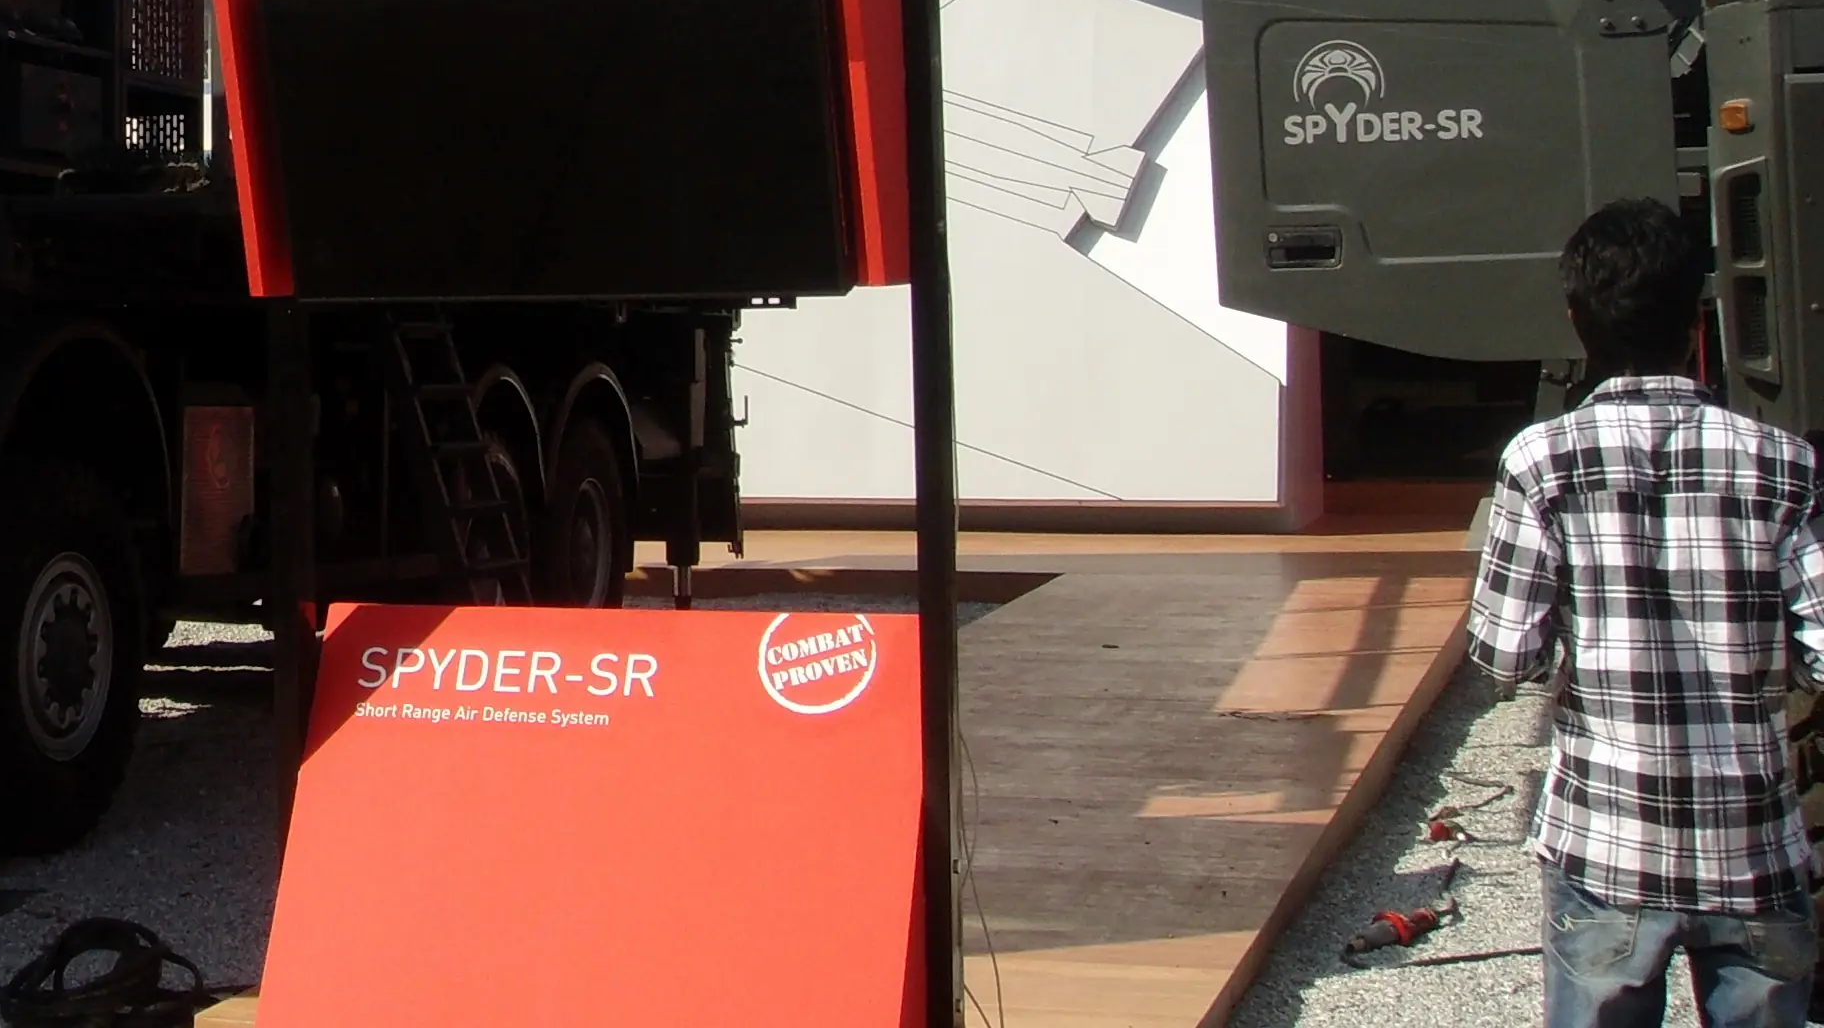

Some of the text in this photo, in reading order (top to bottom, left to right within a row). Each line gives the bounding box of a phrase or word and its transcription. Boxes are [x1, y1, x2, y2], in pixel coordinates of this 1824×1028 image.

[1283, 102, 1484, 145] SPYDER-SR
[767, 624, 864, 665] COMBAT
[357, 646, 658, 697] SPYDER-SR
[772, 648, 868, 691] PROVEN
[355, 702, 610, 727] Short Range Air Defense System
